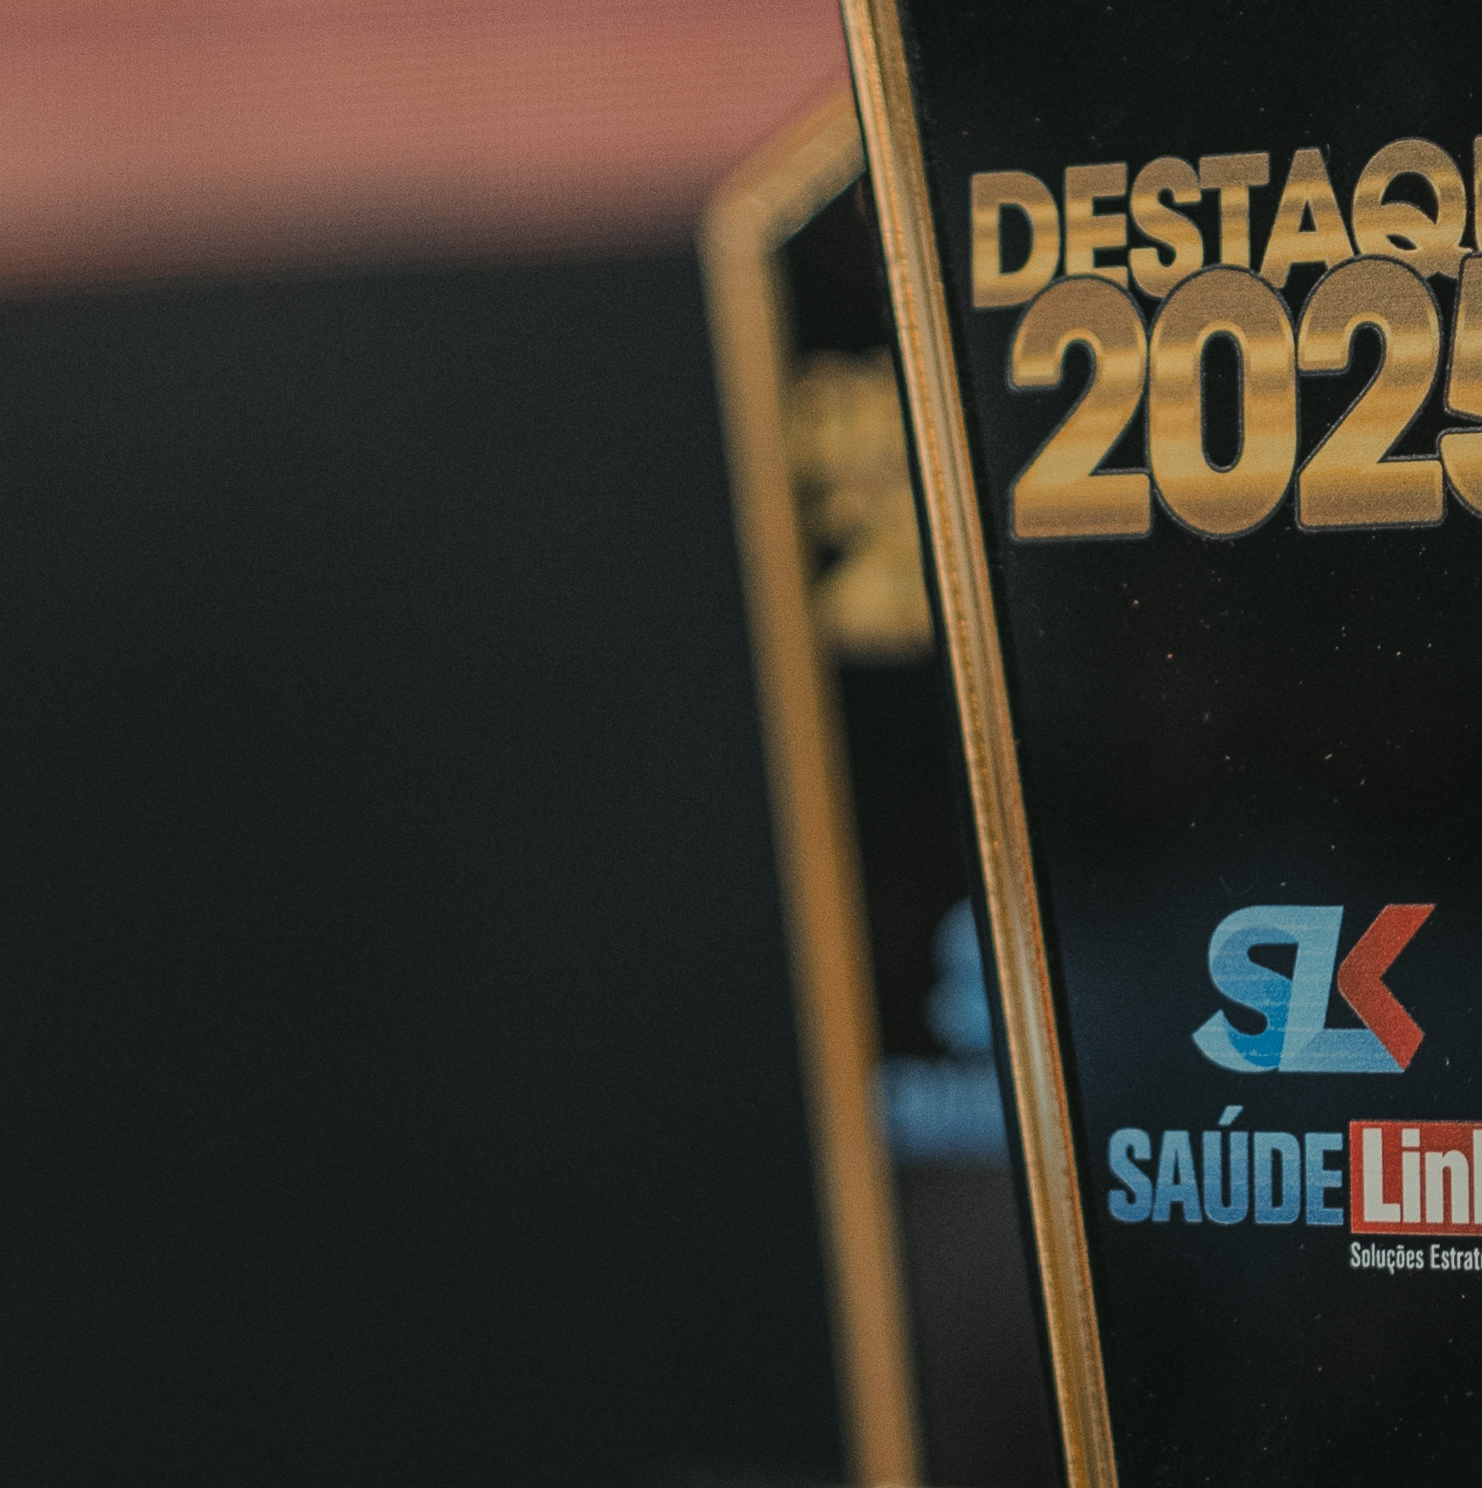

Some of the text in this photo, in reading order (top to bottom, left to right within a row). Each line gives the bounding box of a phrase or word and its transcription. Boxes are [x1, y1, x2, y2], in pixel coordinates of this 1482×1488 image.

[1191, 903, 1437, 1073] SLK
[1107, 1105, 1344, 1226] SAÚDE
[1350, 1241, 1424, 1275] Soluções
